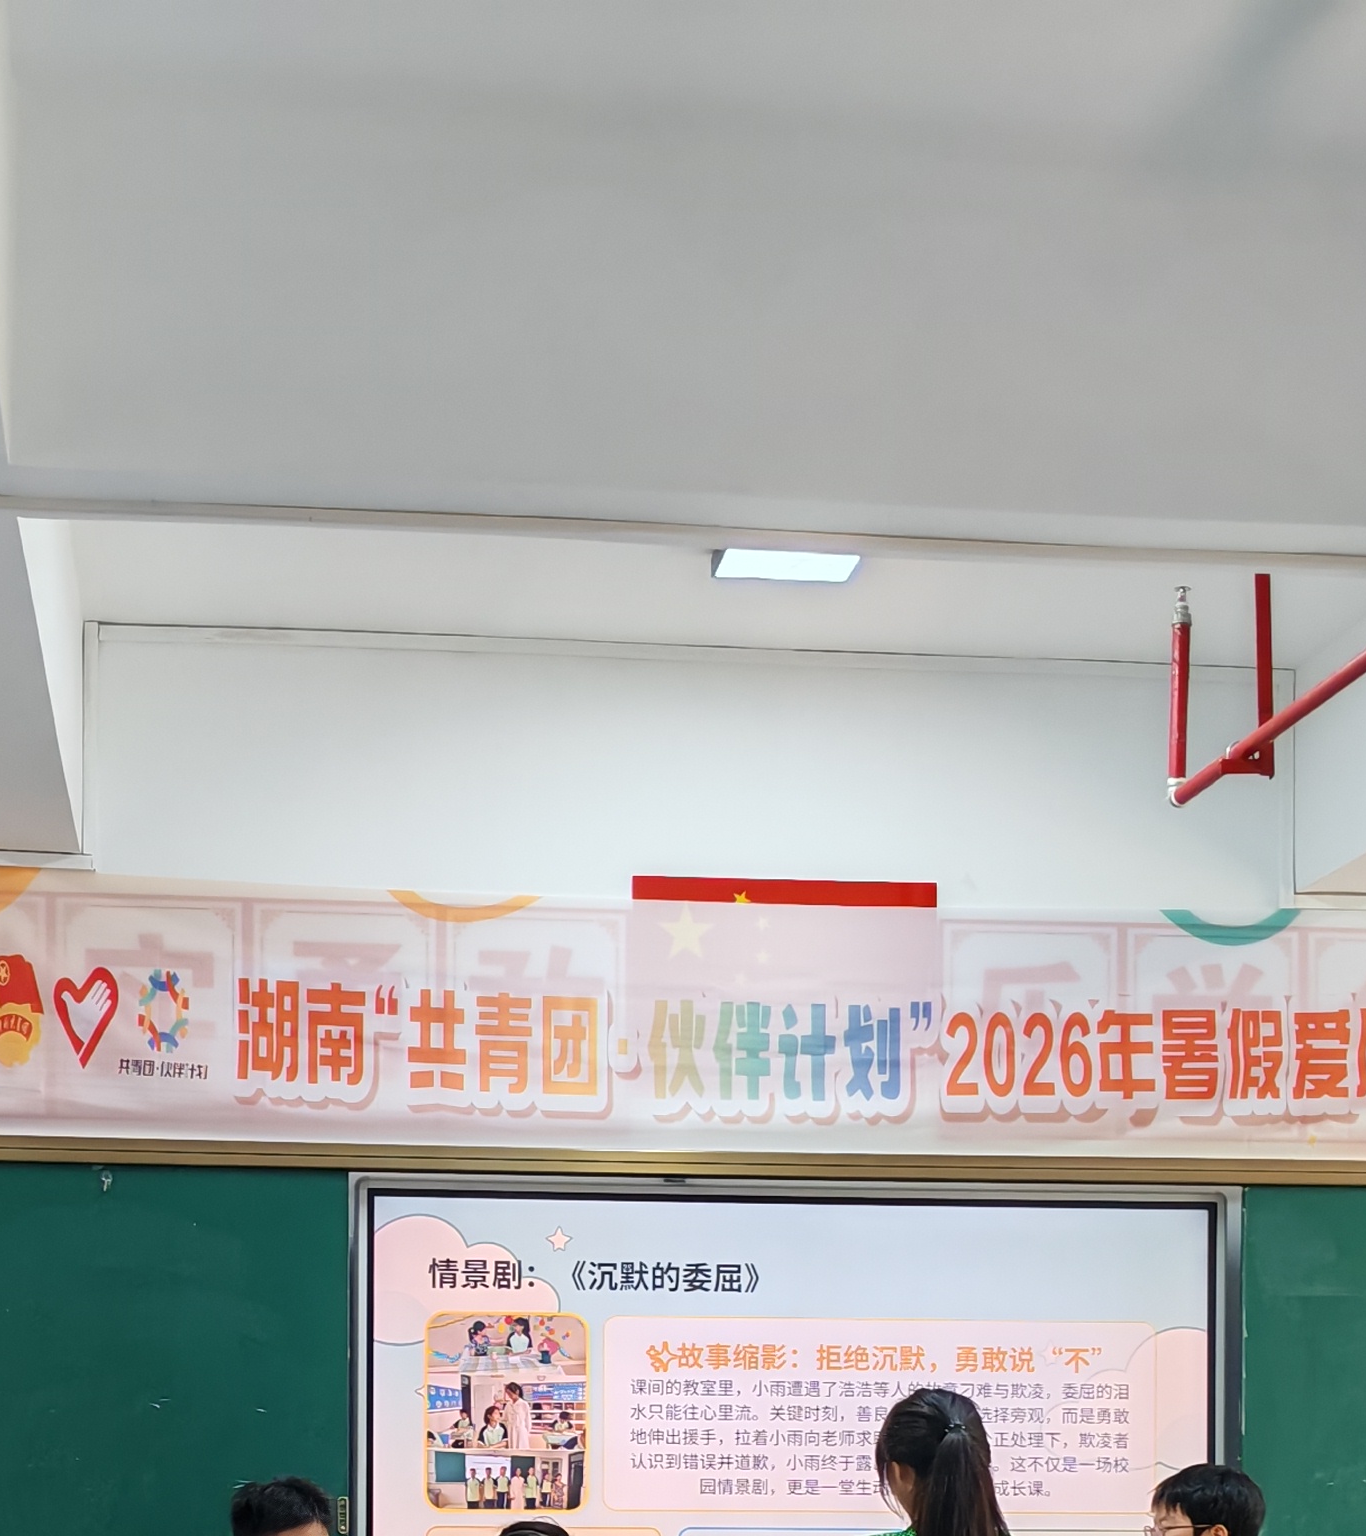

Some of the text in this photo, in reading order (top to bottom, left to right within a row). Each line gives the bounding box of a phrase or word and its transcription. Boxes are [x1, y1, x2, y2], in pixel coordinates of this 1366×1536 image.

[427, 1257, 760, 1293] 情景剧：《沉默的委屈》
[676, 1343, 1102, 1374] 故事缩影：拒绝沉默，勇敢说“不”
[630, 1453, 879, 1471] 认识到错误并道歉，小雨终于露
